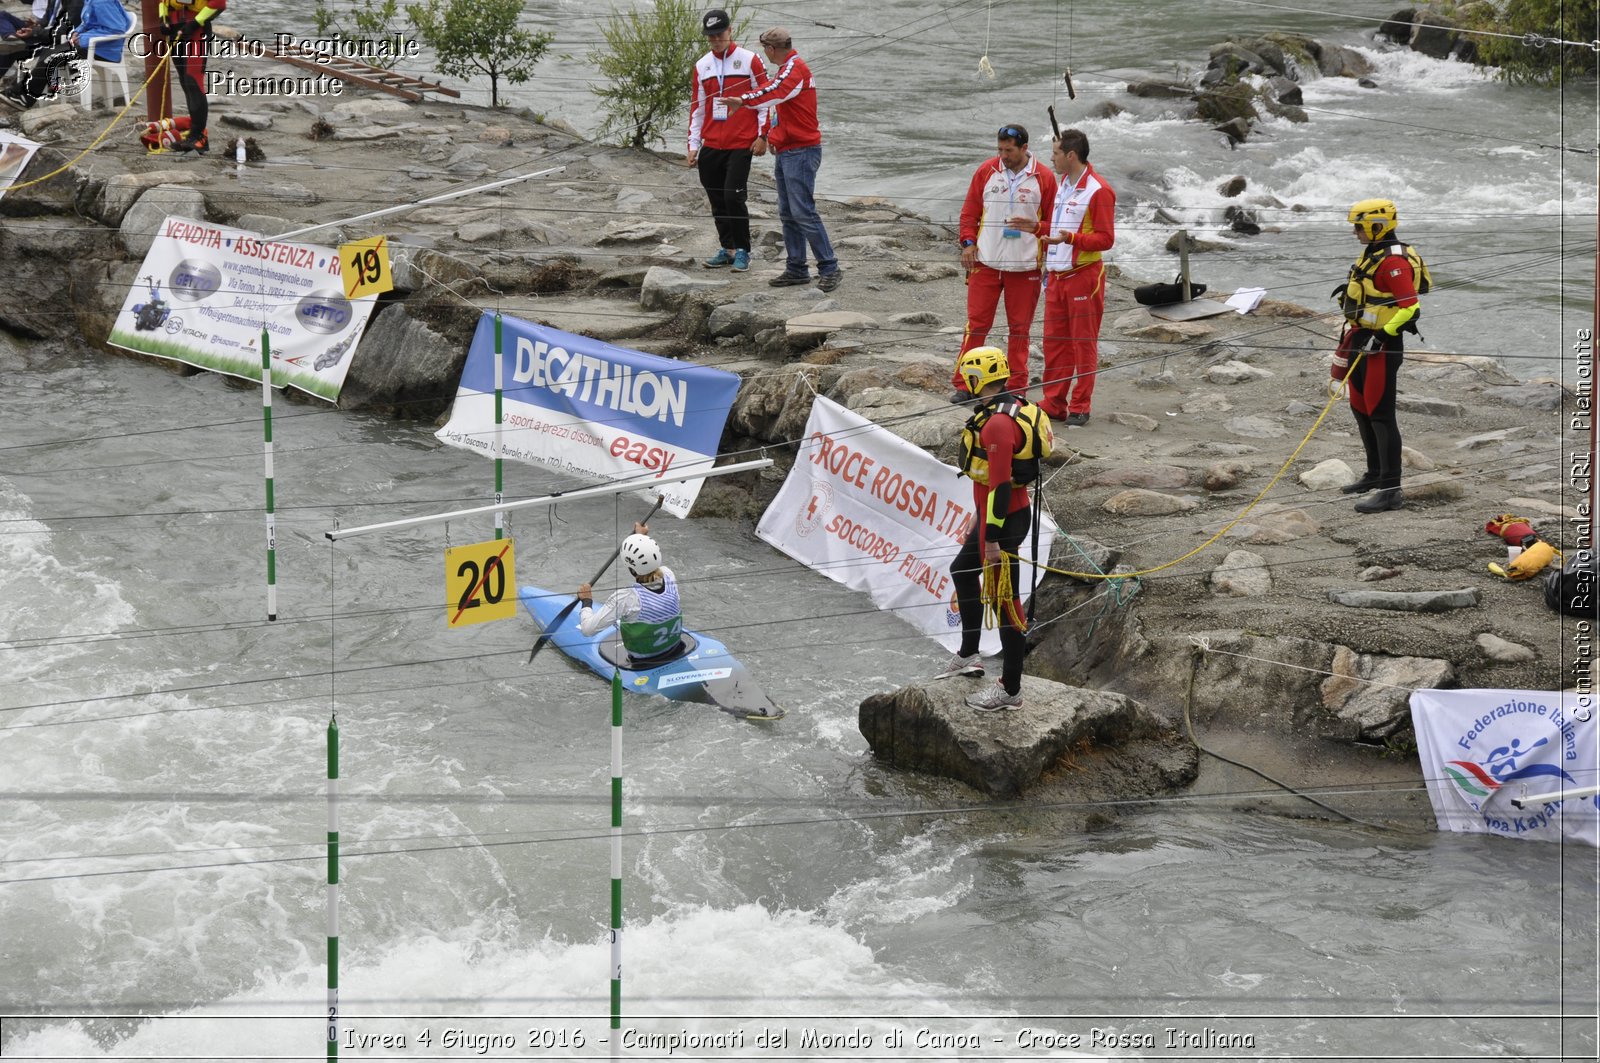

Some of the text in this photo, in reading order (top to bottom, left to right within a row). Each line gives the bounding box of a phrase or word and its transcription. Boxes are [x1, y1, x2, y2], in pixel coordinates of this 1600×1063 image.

[164, 221, 222, 249] VENDITA
[233, 237, 314, 270] ASSISTENZA
[175, 272, 212, 290] GETTO
[351, 249, 381, 285] 19
[182, 327, 208, 340] HITACHI
[302, 304, 345, 324] GETTO
[513, 336, 687, 428] DECATHLON
[462, 433, 489, 449] Toscana
[501, 444, 521, 458] Burolo
[547, 455, 562, 469] (TO)
[509, 414, 534, 431] sport
[540, 422, 570, 439] prezzi
[570, 428, 605, 449] discount
[609, 436, 676, 478] easy
[809, 431, 878, 490] CROCE
[871, 465, 939, 526] ROSSA
[936, 500, 971, 545] ITA
[825, 513, 900, 565] SOCCORSO
[457, 555, 506, 611] 20
[653, 618, 681, 648] 24
[1458, 699, 1577, 761] Federazione Italiana
